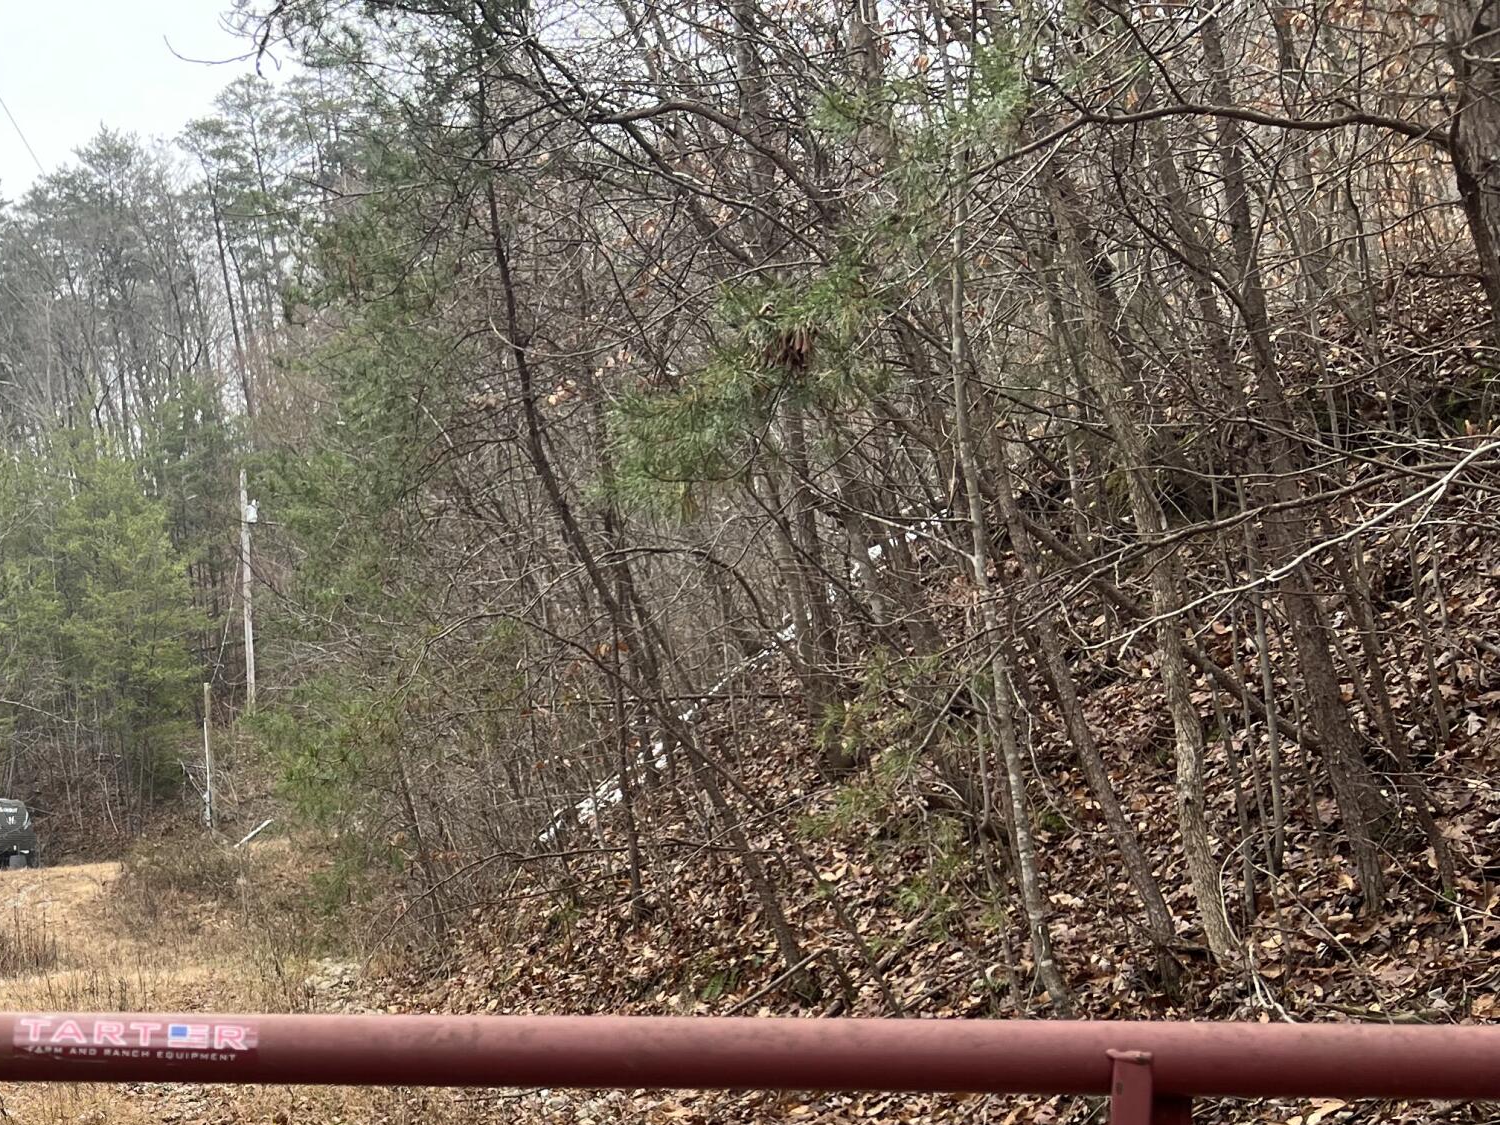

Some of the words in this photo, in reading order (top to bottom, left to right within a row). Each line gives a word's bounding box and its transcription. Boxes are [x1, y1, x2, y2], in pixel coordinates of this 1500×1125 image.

[20, 1018, 249, 1050] TARTER
[69, 1047, 97, 1055] AND
[104, 1048, 150, 1058] RANCH
[156, 1051, 236, 1061] EQUIPMENT
